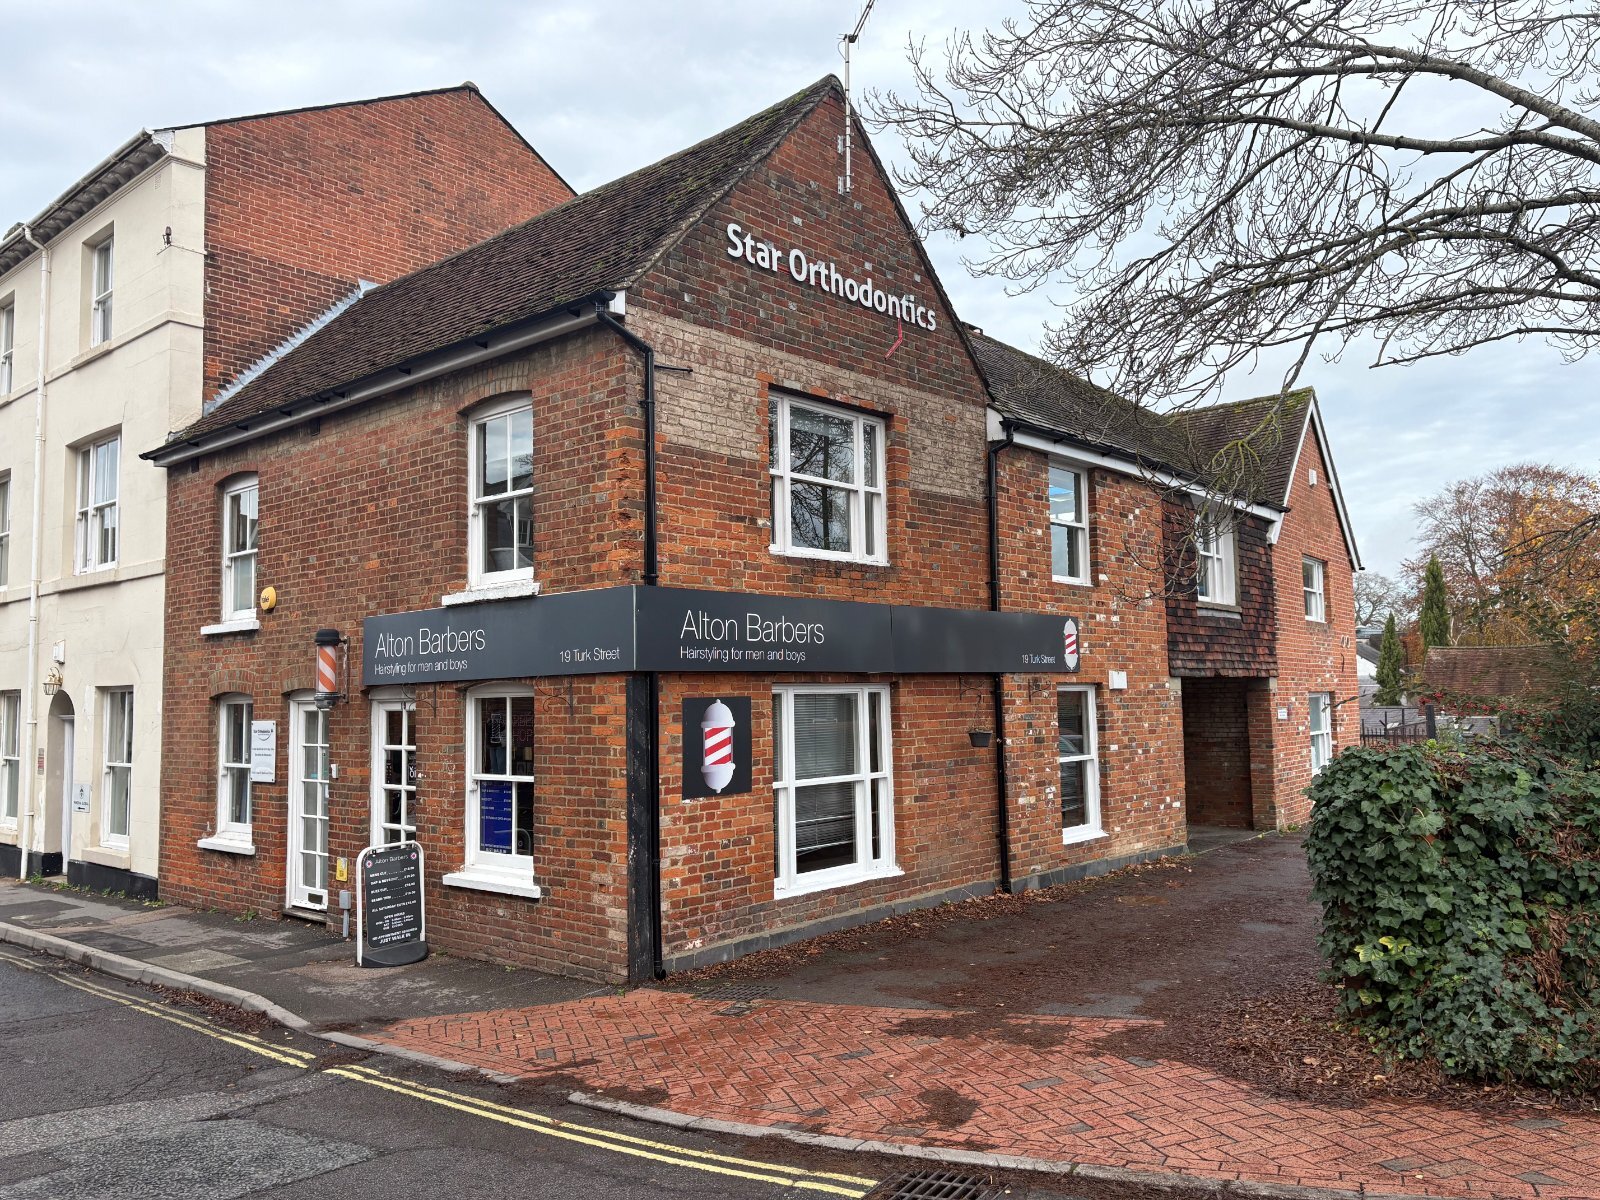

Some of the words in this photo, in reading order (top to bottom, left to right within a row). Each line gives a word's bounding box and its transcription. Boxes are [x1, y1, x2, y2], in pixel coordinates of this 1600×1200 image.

[727, 223, 782, 272] Star
[789, 248, 937, 331] Orthodontics
[680, 609, 738, 641] Alton
[746, 613, 825, 644] Barbers
[374, 632, 414, 659] Alton
[419, 625, 486, 655] Barbers
[559, 650, 571, 663] 19
[573, 648, 592, 662] Turk
[593, 646, 620, 661] Street
[680, 646, 729, 662] Hairstyling
[731, 647, 744, 660] for
[745, 651, 765, 660] men
[767, 649, 784, 660] and
[786, 649, 806, 663] boys
[1022, 654, 1029, 664] 19
[1030, 654, 1041, 664] Turk
[1041, 654, 1056, 664] Street
[374, 662, 407, 676] Hairstyling
[407, 662, 417, 673] for
[417, 662, 433, 672] men
[434, 659, 448, 671] and
[450, 658, 468, 671] boys
